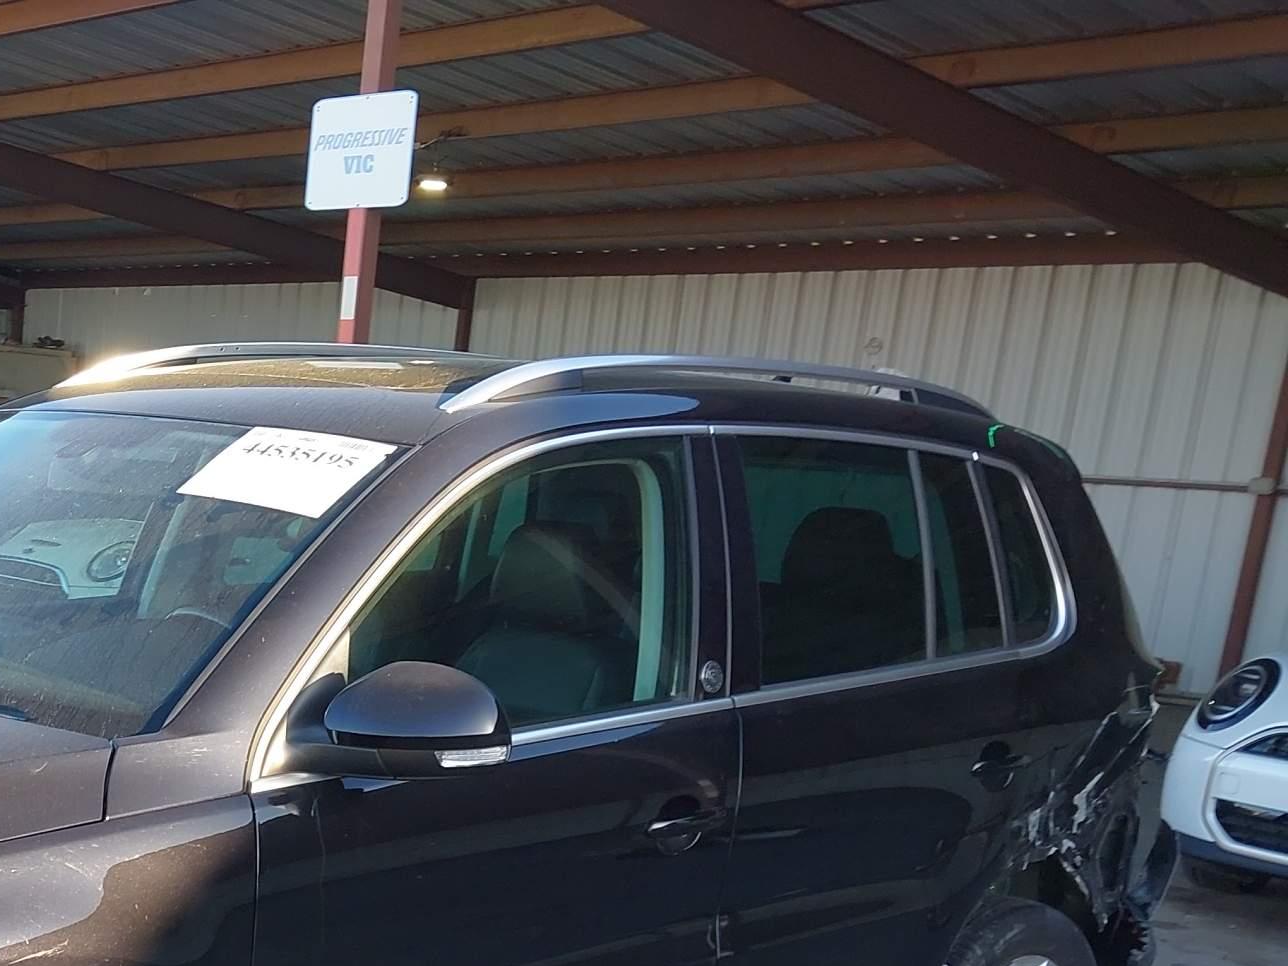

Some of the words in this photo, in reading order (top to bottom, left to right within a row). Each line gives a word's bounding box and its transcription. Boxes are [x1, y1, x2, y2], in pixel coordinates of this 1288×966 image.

[314, 128, 408, 152] PROGRESSIVE
[343, 154, 375, 174] VIC
[242, 442, 360, 469] 44535195
